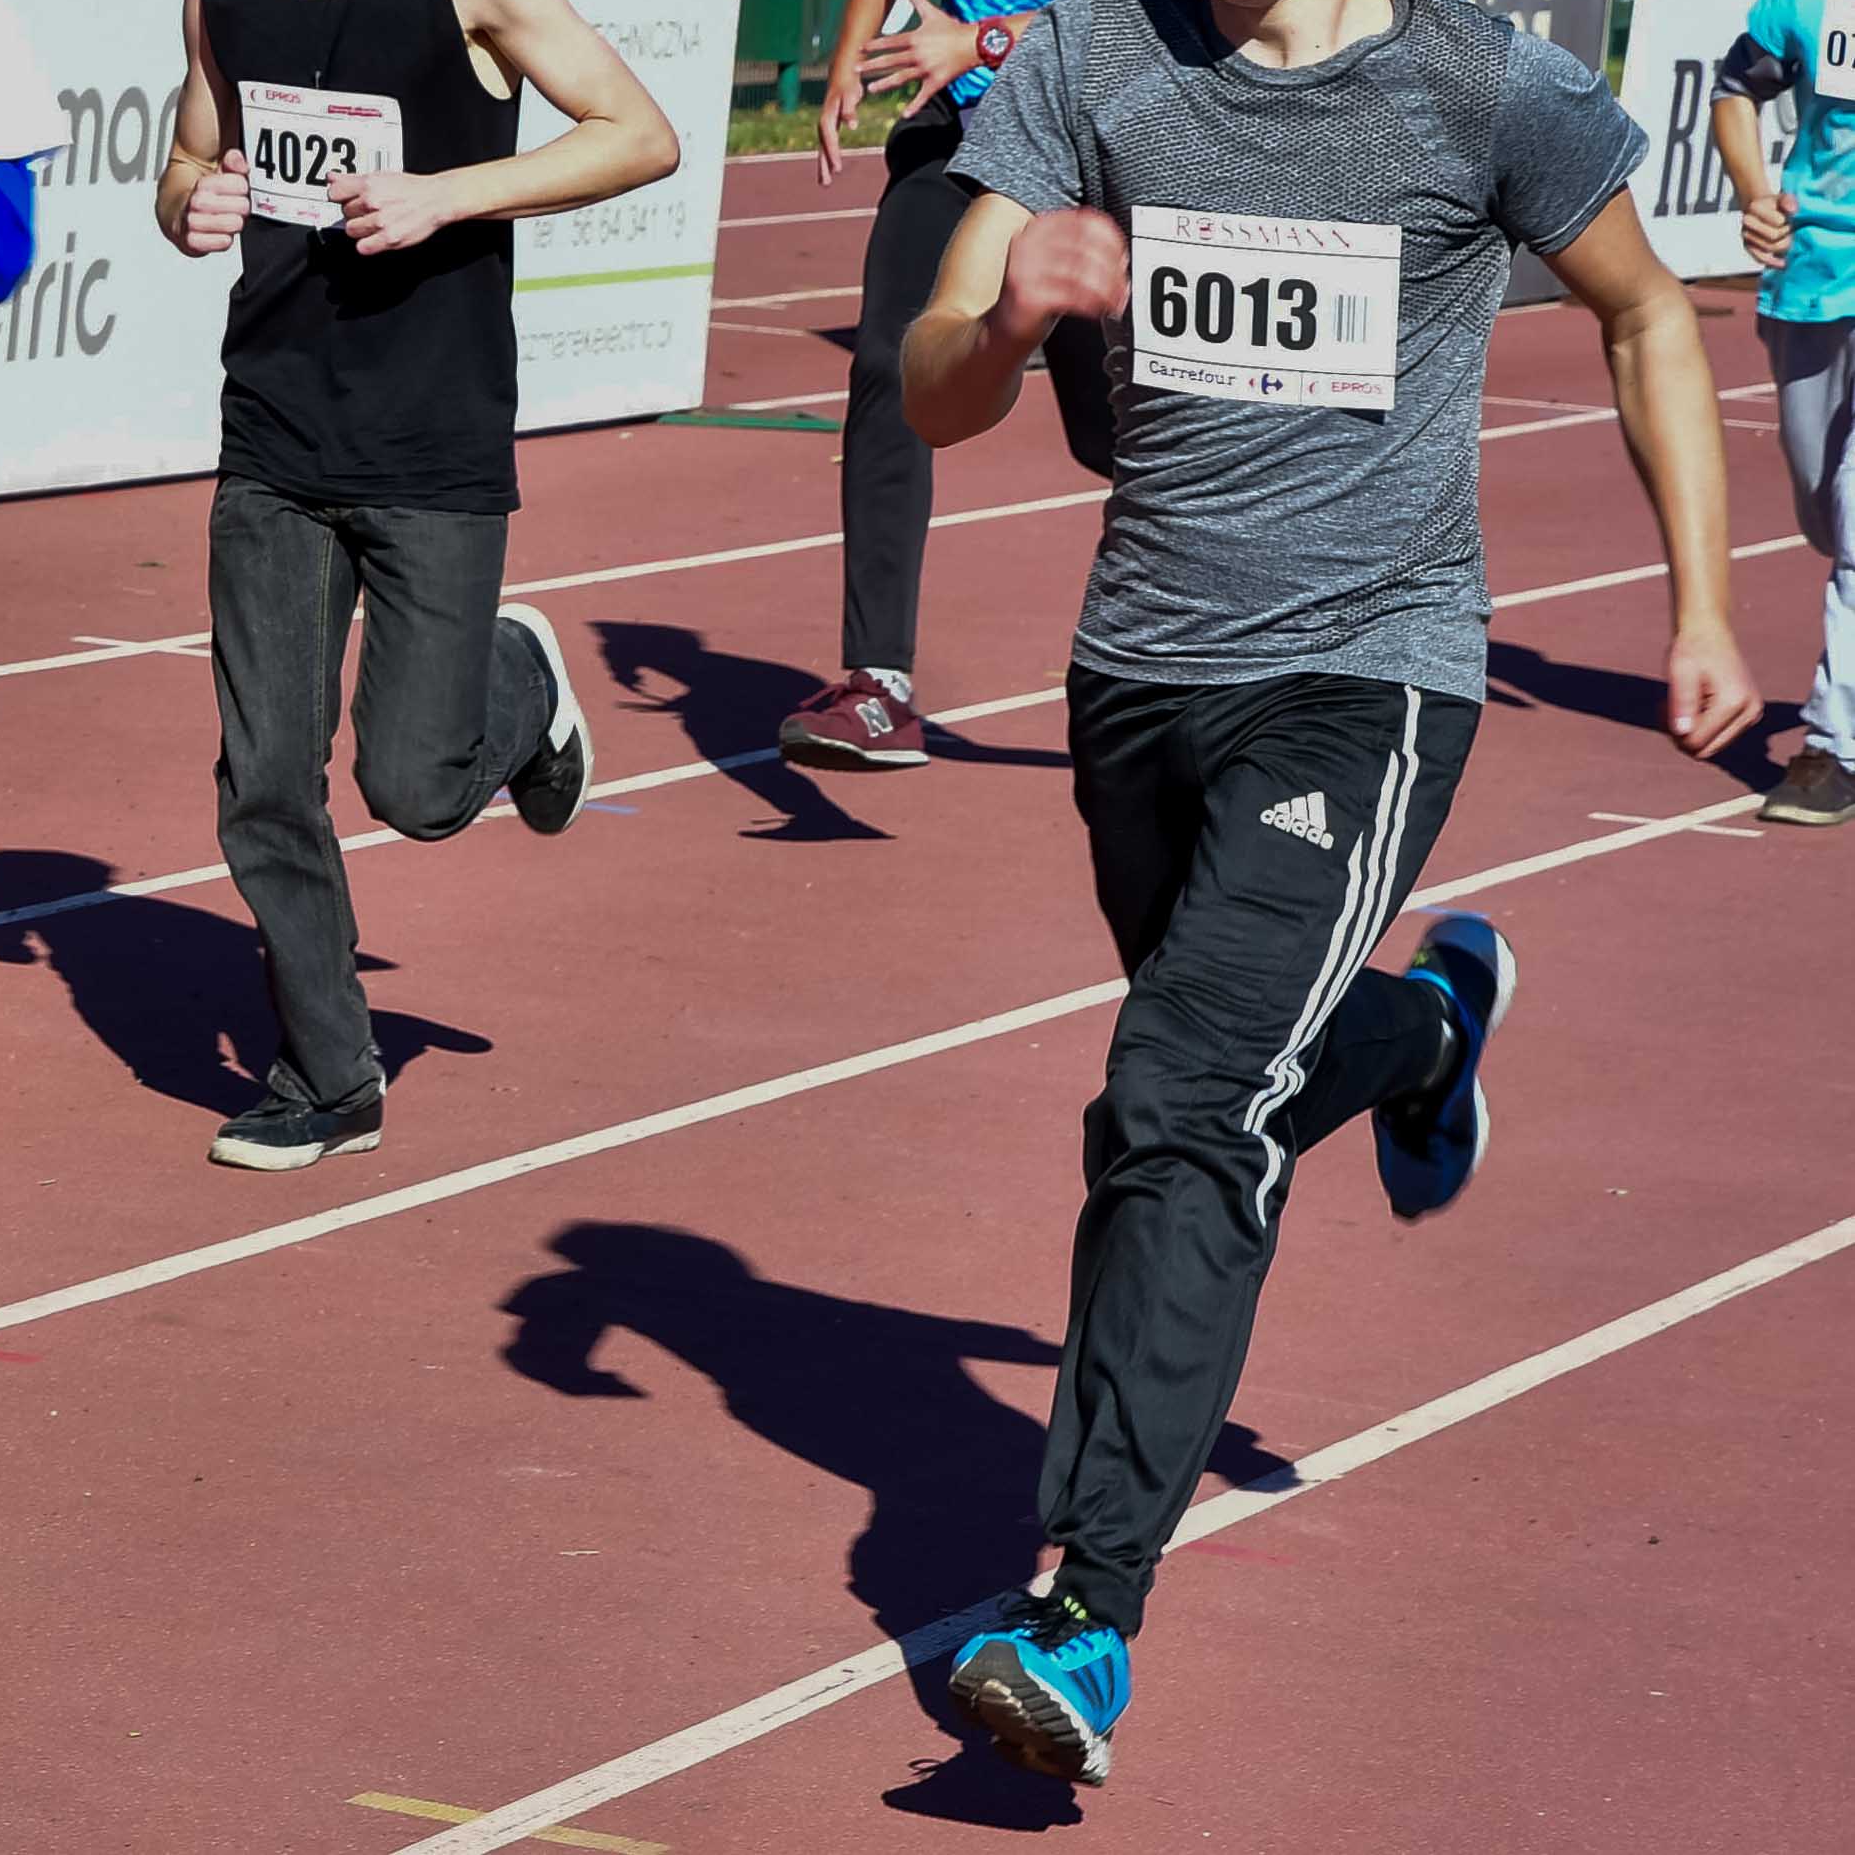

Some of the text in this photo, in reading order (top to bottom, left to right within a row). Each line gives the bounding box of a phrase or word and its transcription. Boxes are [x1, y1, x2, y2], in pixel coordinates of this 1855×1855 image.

[1826, 30, 1855, 67] 0
[255, 128, 357, 188] 4023
[1149, 265, 1318, 351] 6013
[1148, 359, 1238, 388] Carrefour
